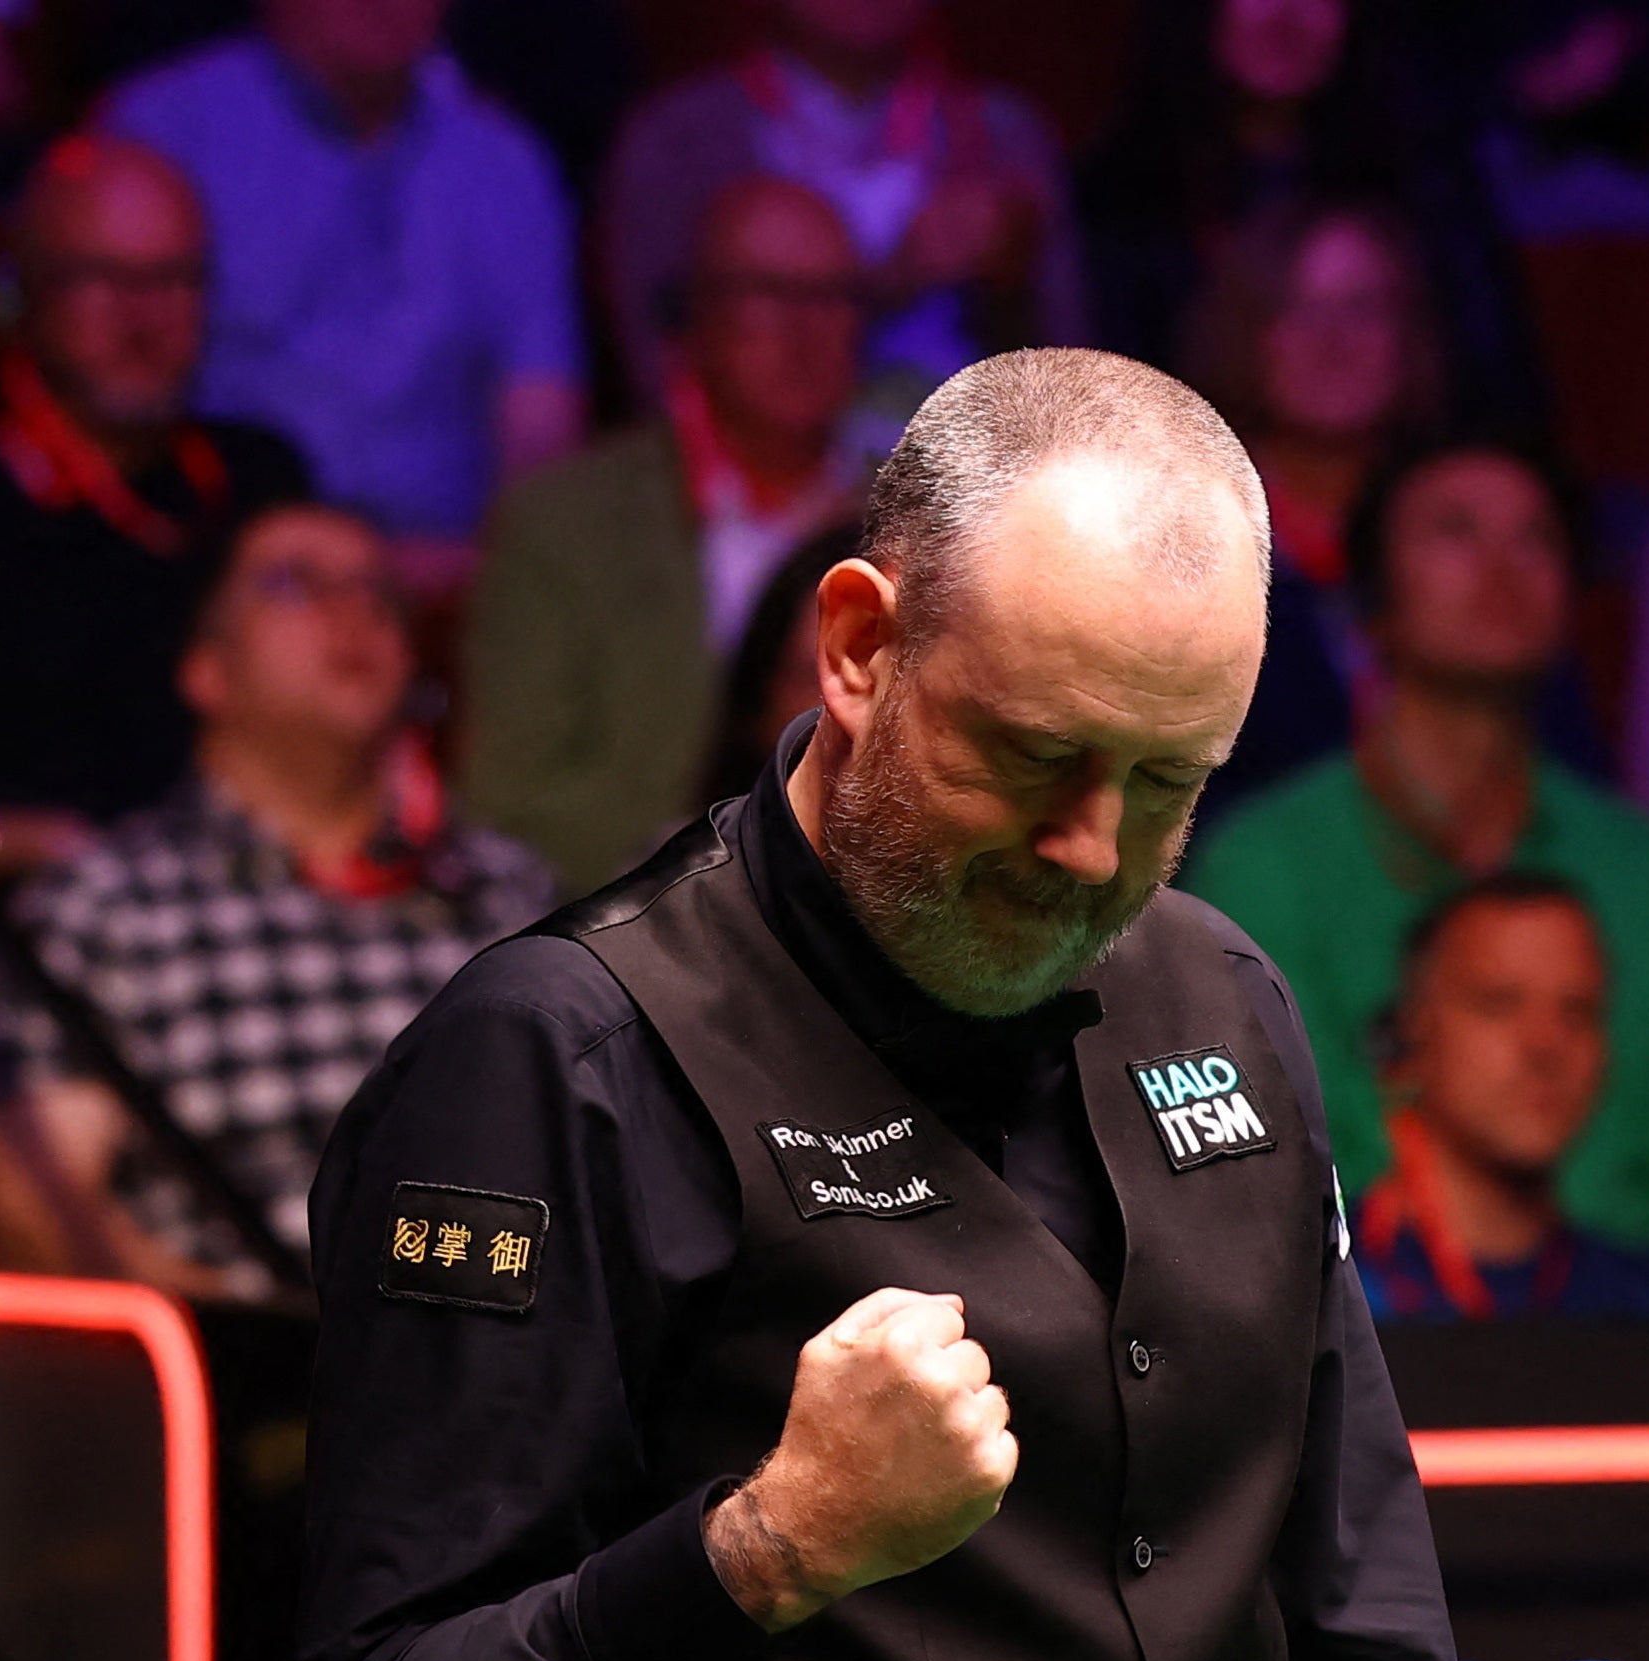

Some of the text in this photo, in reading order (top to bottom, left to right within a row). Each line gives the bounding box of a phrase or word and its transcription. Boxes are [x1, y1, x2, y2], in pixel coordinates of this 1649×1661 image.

[1138, 1057, 1237, 1109] HALO
[771, 1127, 821, 1148] Ron
[1159, 1093, 1265, 1157] ITSM
